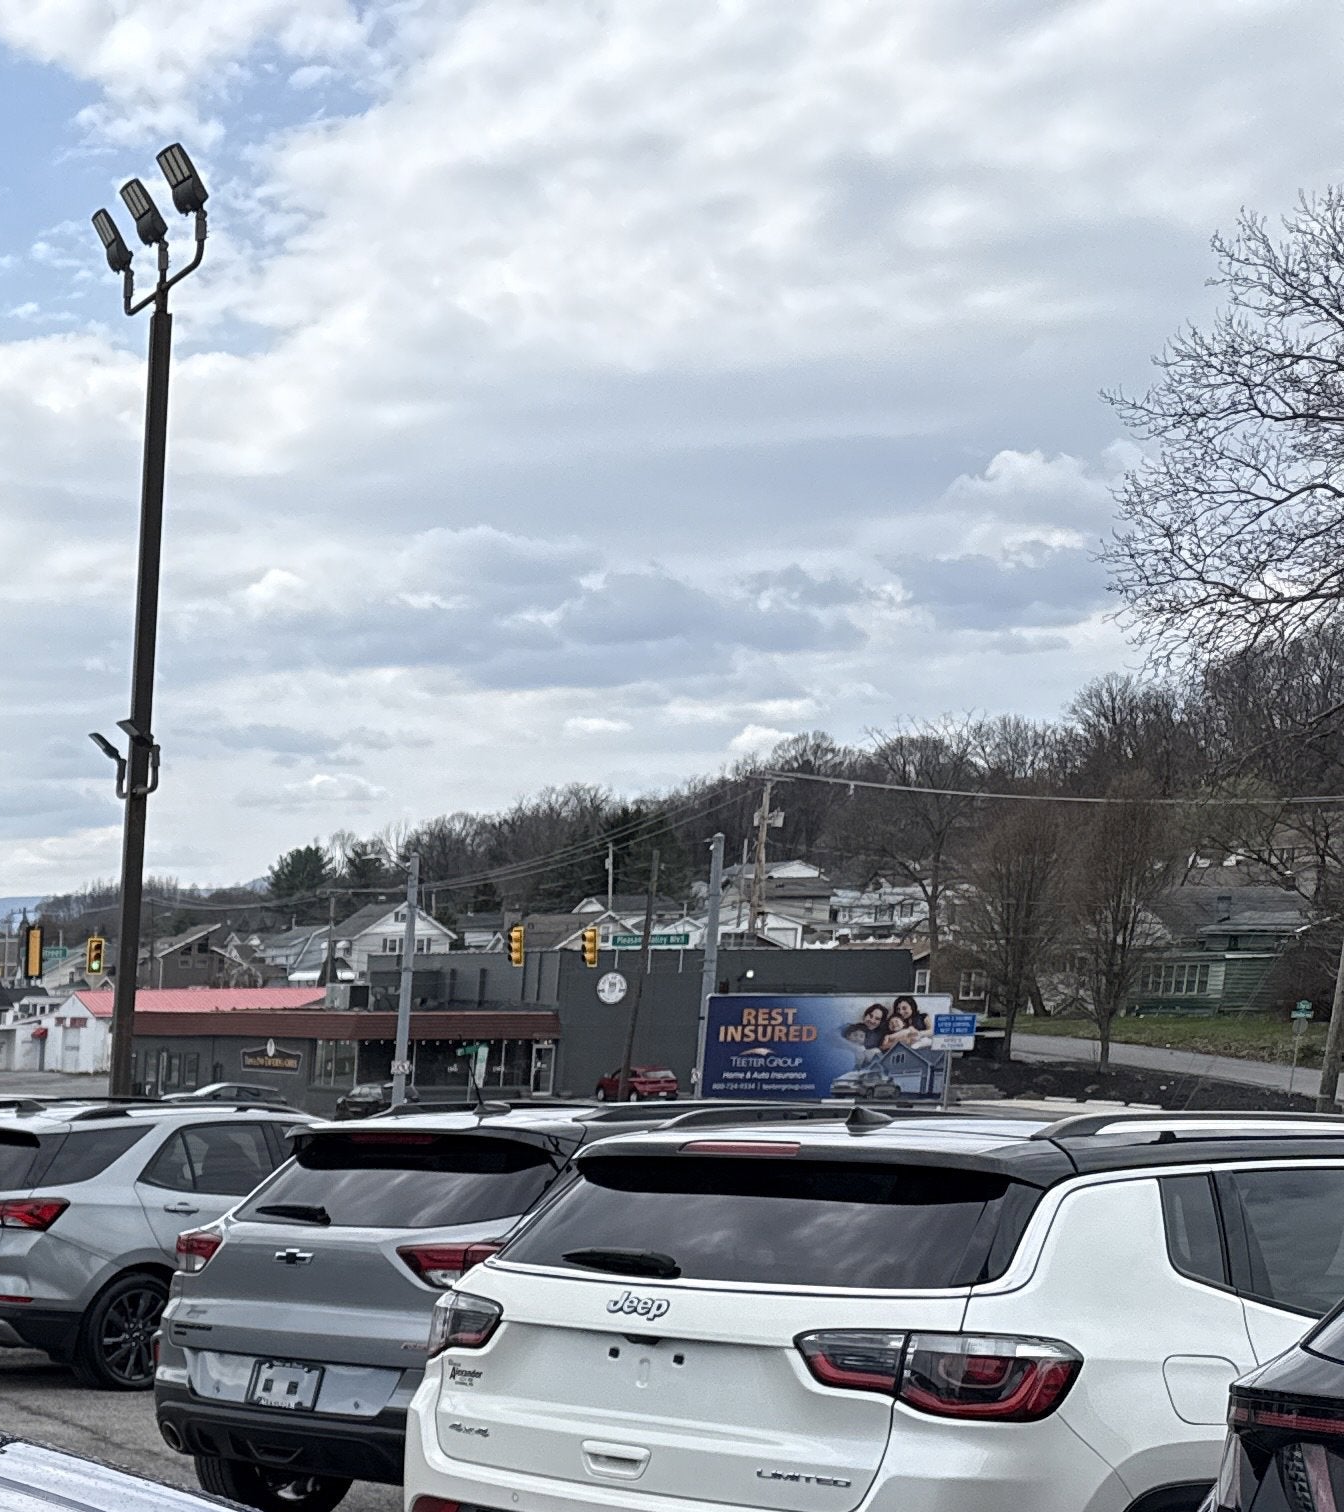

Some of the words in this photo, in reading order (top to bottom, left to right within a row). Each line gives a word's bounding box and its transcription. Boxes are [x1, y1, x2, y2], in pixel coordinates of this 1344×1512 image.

[742, 1008, 797, 1025] REST
[718, 1025, 817, 1043] INSURED
[765, 1056, 803, 1068] GROUP
[770, 1071, 807, 1080] Insurance
[607, 1290, 671, 1321] Jeep
[756, 1467, 852, 1488] LIMITED
